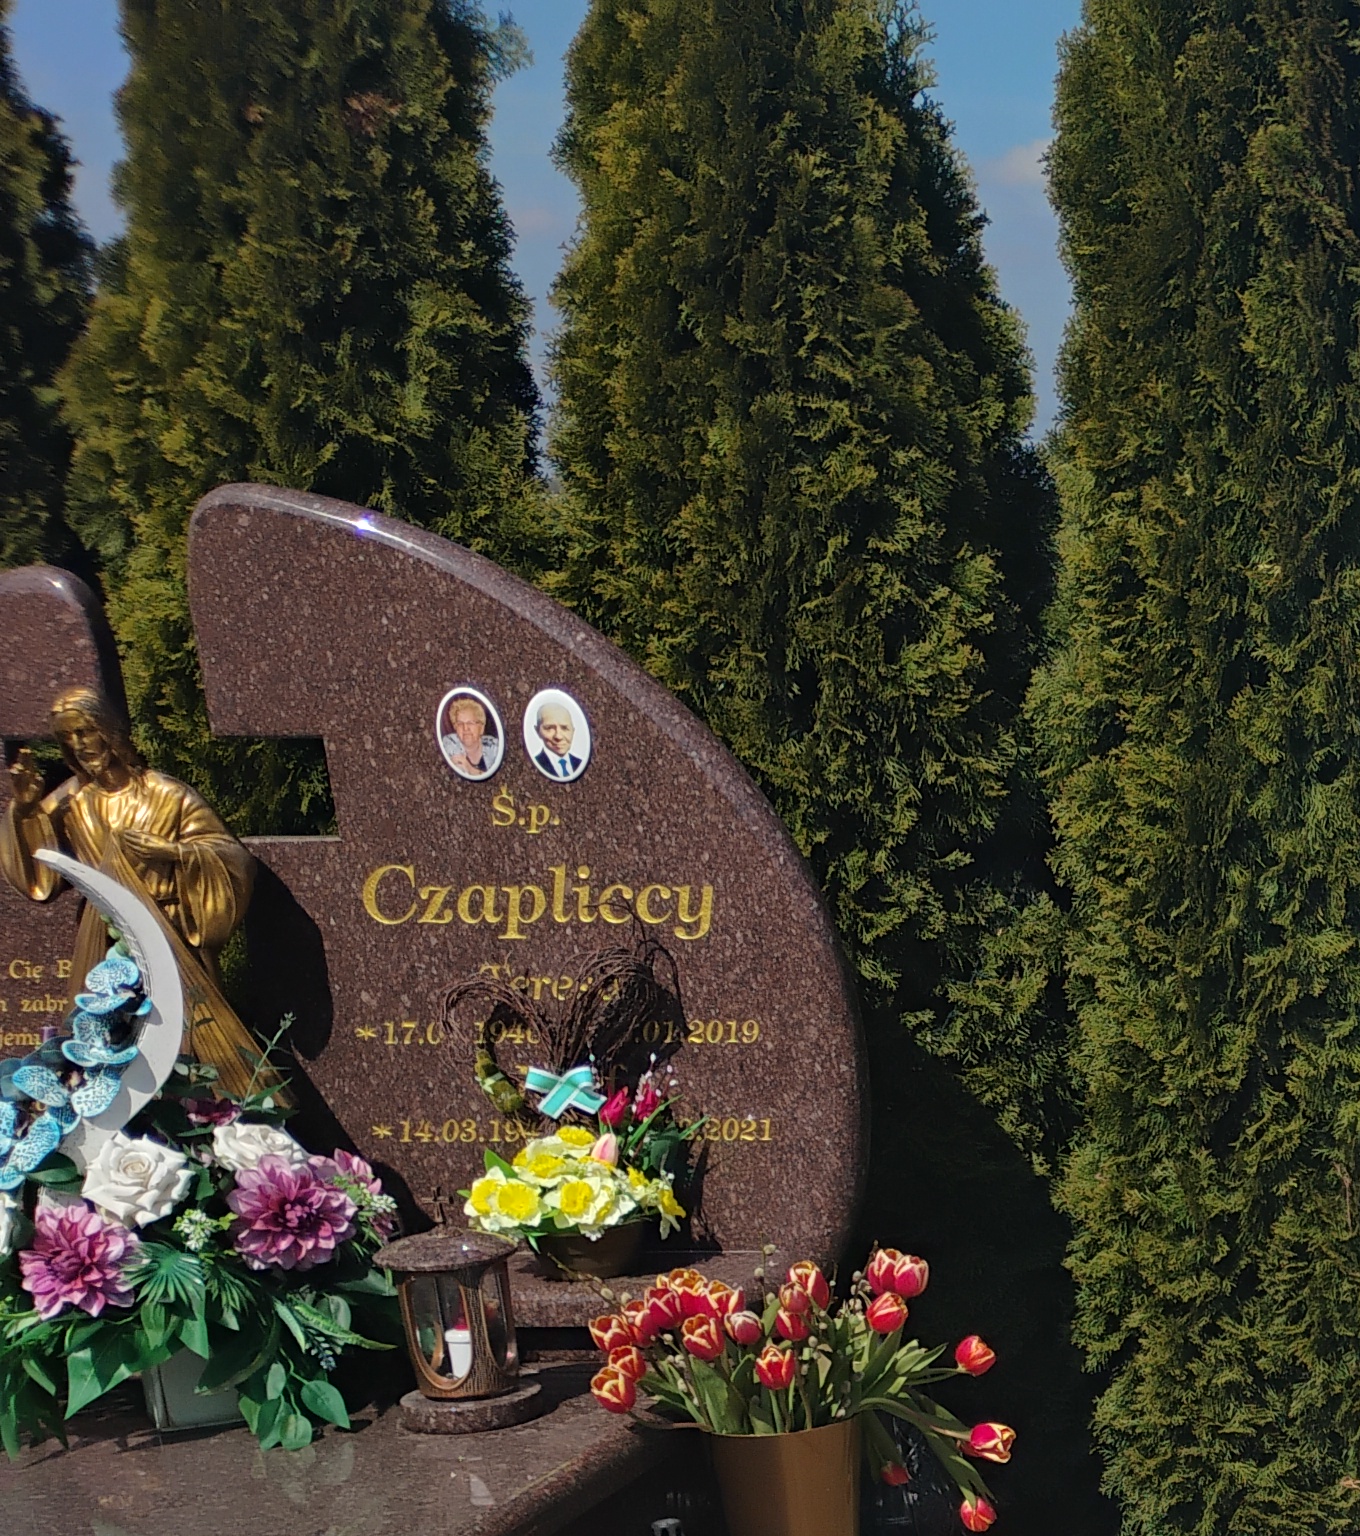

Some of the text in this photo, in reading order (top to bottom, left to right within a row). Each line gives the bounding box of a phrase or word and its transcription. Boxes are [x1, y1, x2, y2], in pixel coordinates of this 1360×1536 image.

[491, 784, 561, 834] Ś.p.
[362, 863, 714, 940] Czapliccy
[9, 959, 43, 983] Cię
[21, 993, 69, 1012] zabr
